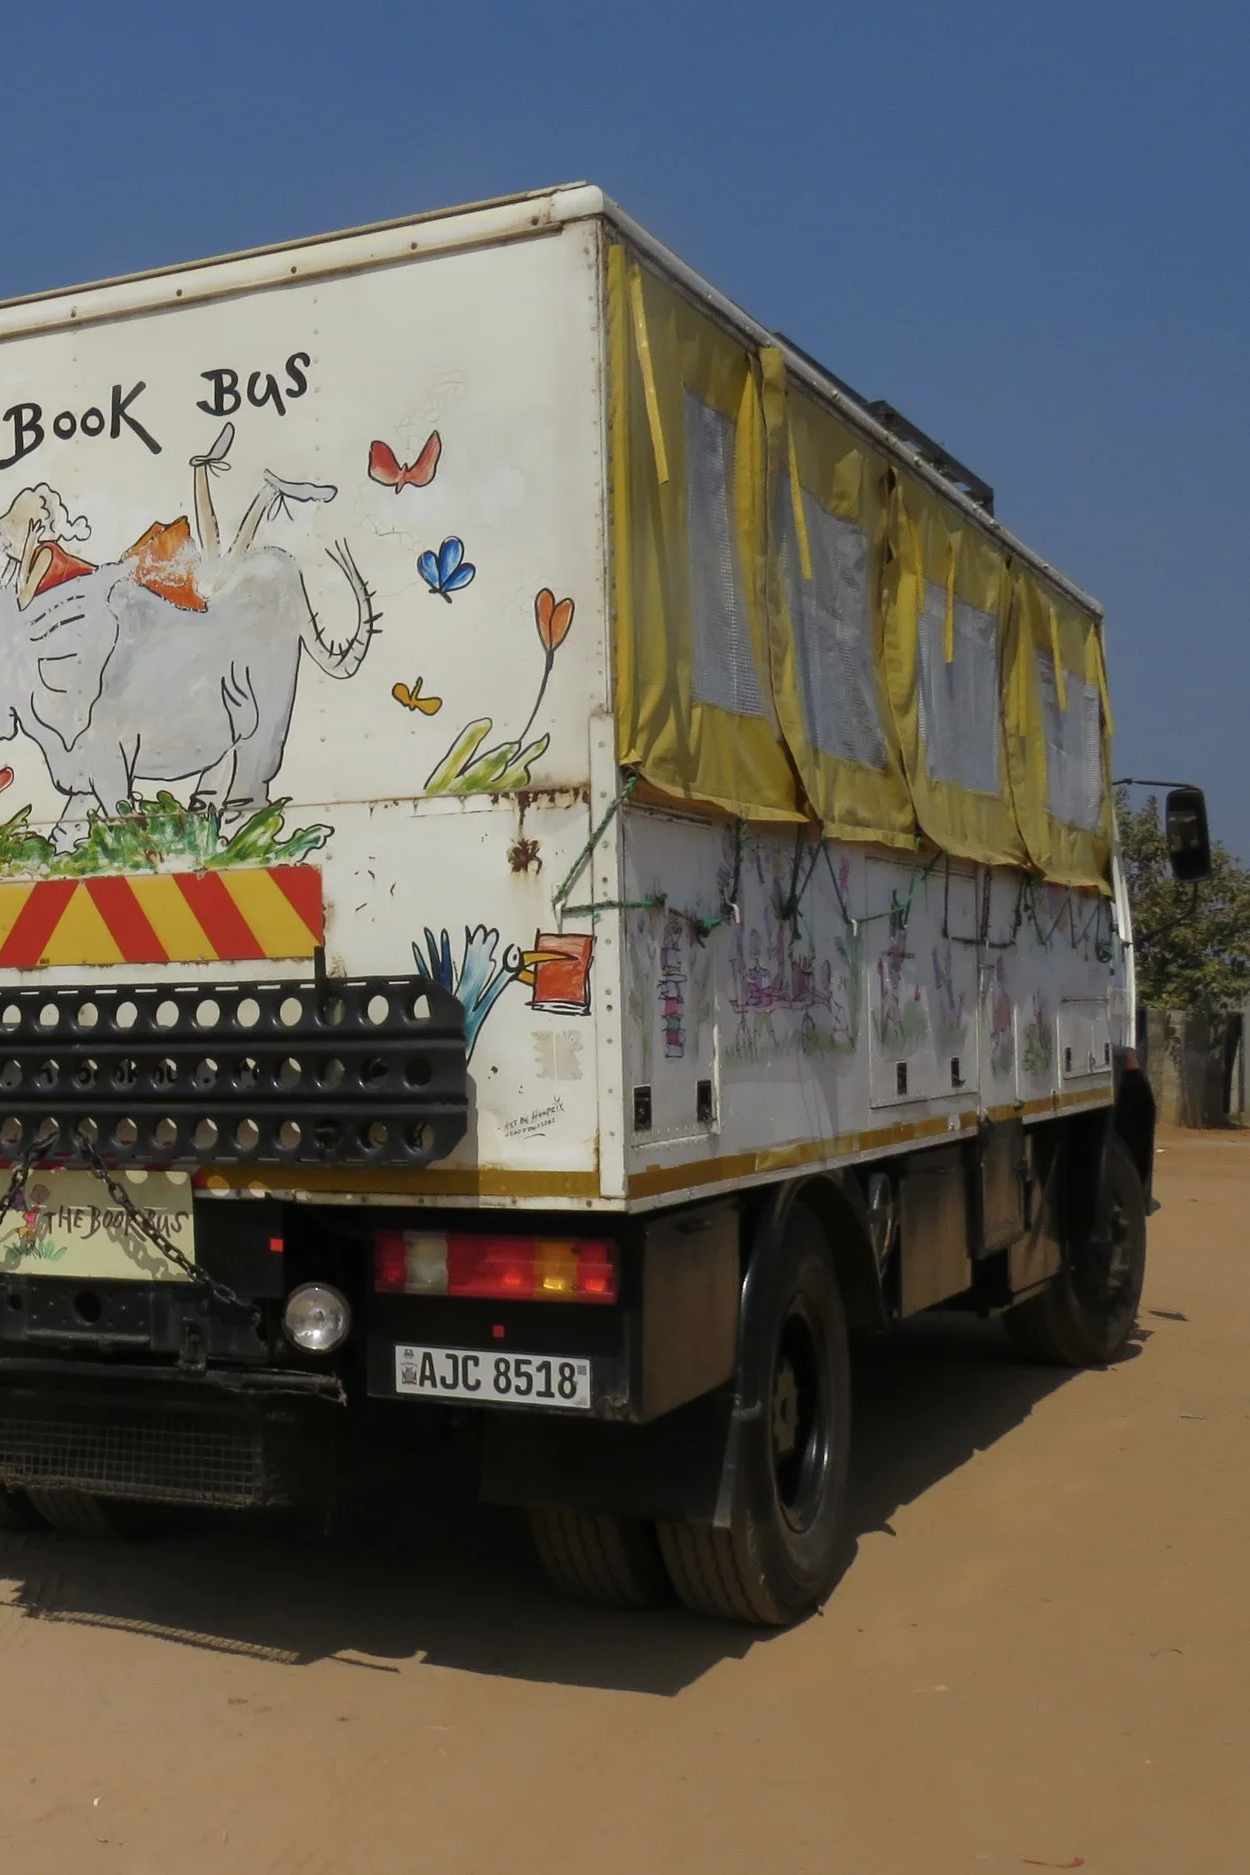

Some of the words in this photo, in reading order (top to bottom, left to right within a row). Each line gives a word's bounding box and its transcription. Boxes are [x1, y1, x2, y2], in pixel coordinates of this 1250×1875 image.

[42, 1204, 85, 1235] THE
[418, 1351, 482, 1391] AJC
[493, 1357, 577, 1400] 8518
